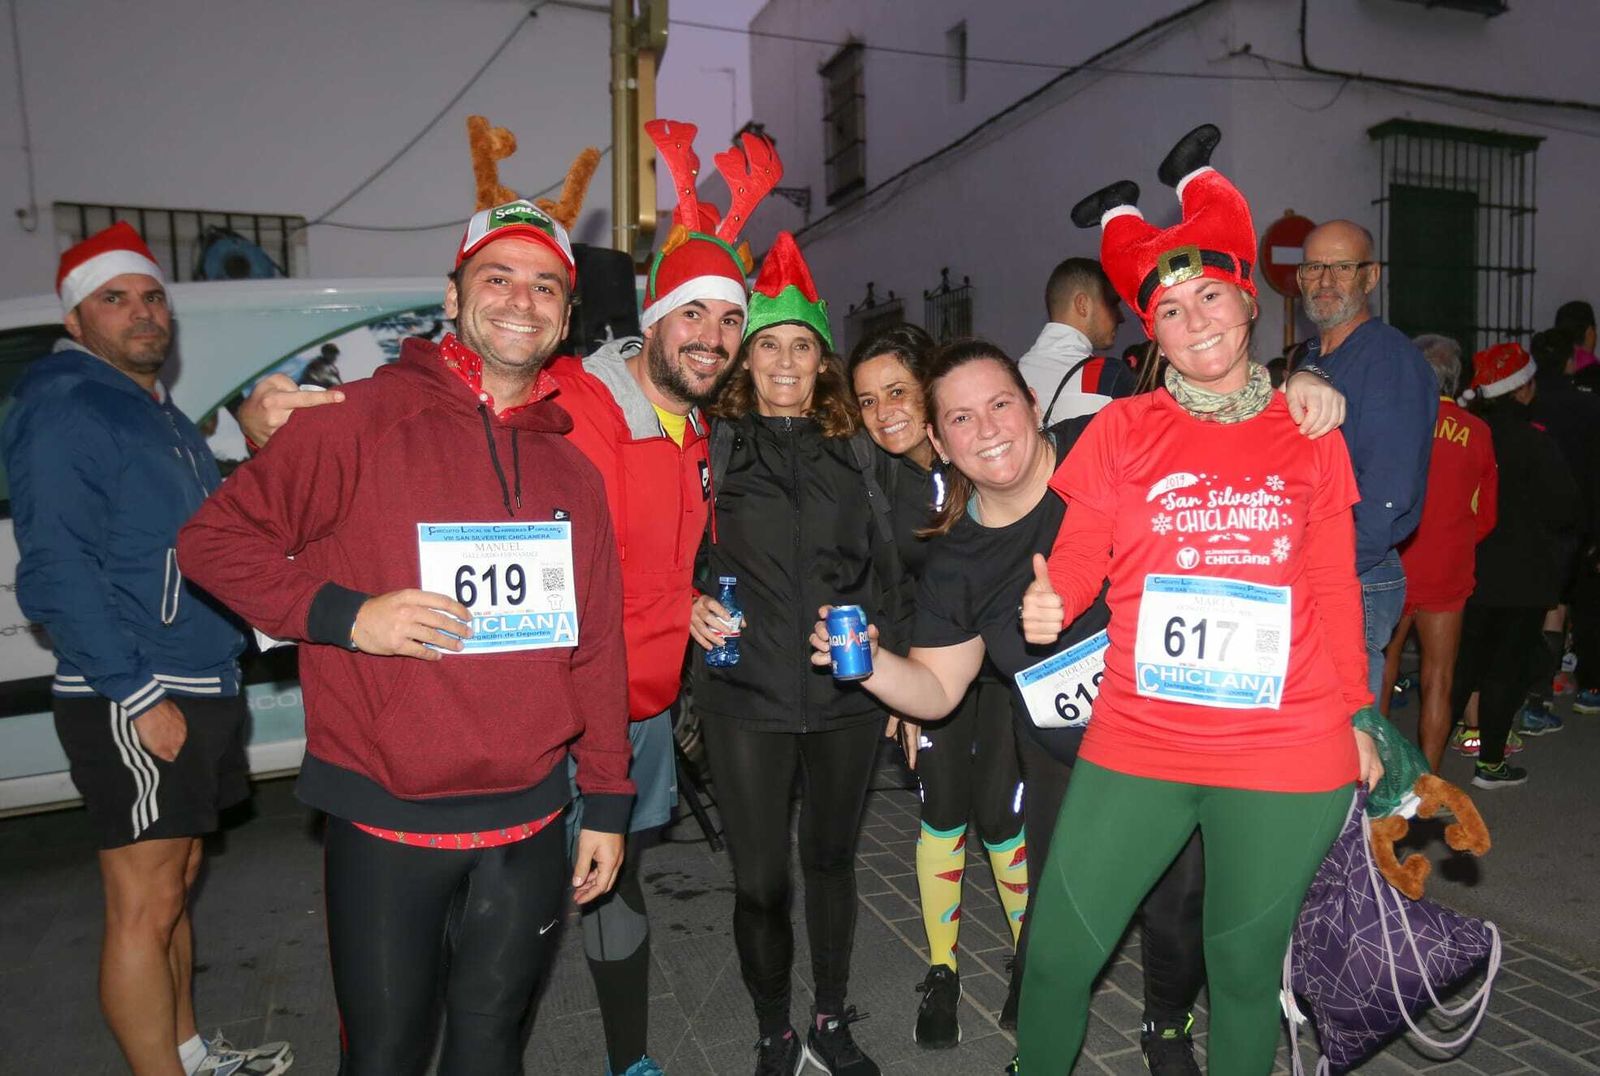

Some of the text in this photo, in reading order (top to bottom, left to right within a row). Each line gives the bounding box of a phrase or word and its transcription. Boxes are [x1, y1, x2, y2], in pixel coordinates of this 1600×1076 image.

[1165, 486, 1284, 511] San Silvestre
[1176, 507, 1280, 533] CHICLANERA
[474, 542, 524, 552] MANUEL
[508, 533, 551, 541] CHICLANERA
[455, 563, 527, 608] 619
[466, 612, 575, 642] ICLANA
[516, 630, 551, 638] Deportes
[1164, 616, 1239, 662] 617
[1139, 664, 1276, 704] CHICLANA
